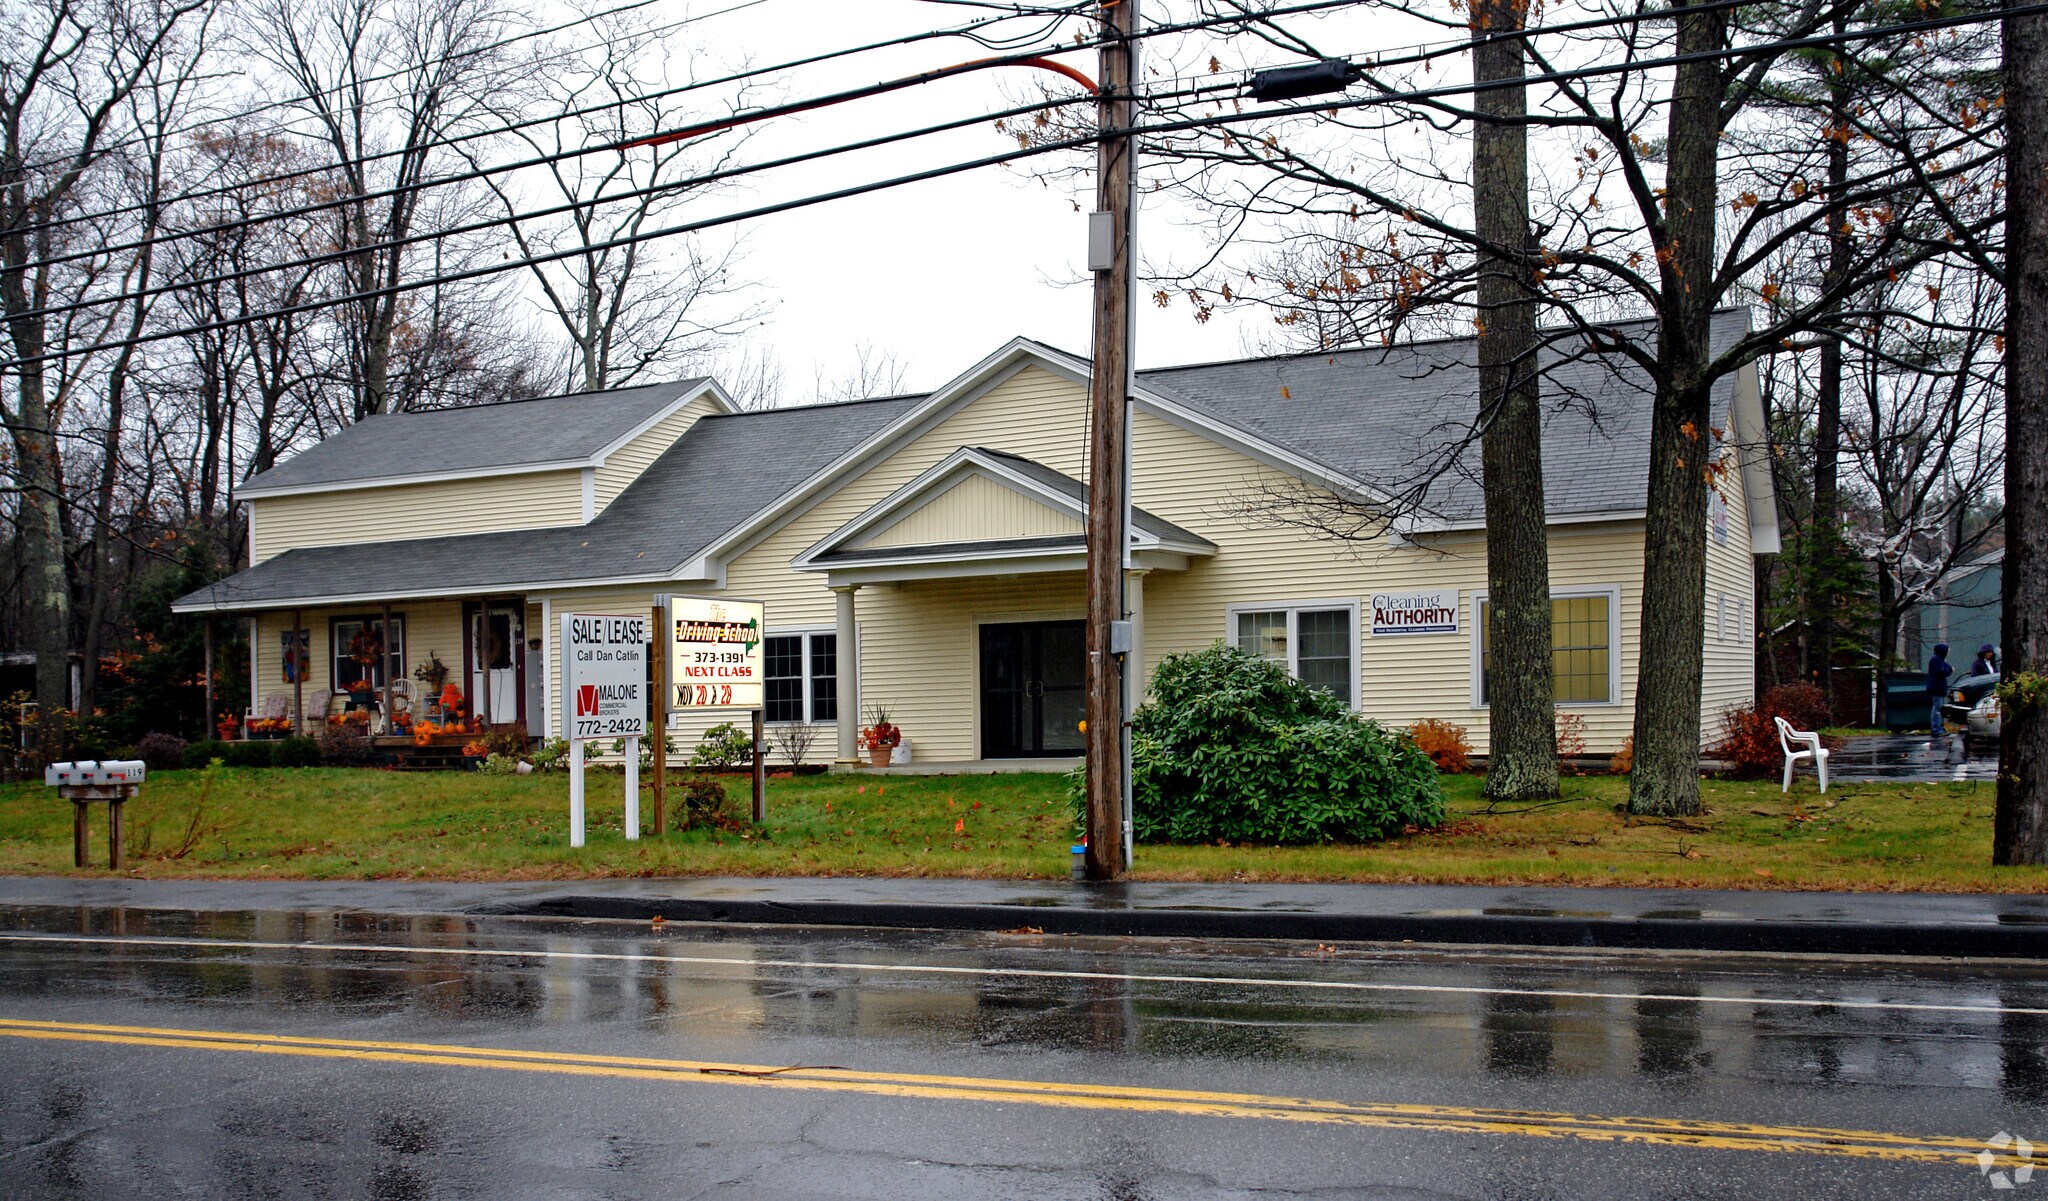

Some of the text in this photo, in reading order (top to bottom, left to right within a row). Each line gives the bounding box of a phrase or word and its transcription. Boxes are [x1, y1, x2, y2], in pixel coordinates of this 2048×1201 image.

[1373, 595, 1440, 611] Cleaning
[572, 617, 643, 647] SALE/LEASE
[677, 620, 760, 646] Driving School
[577, 650, 639, 661] Call Dan Catlin
[695, 652, 744, 663] 373-1391
[685, 666, 752, 677] NEXT CLASS
[599, 684, 638, 701] MALONE
[677, 685, 693, 705] NOV
[696, 685, 707, 705] 20
[721, 685, 732, 705] 28
[577, 718, 642, 735] 772-2422
[127, 768, 142, 777] 119
